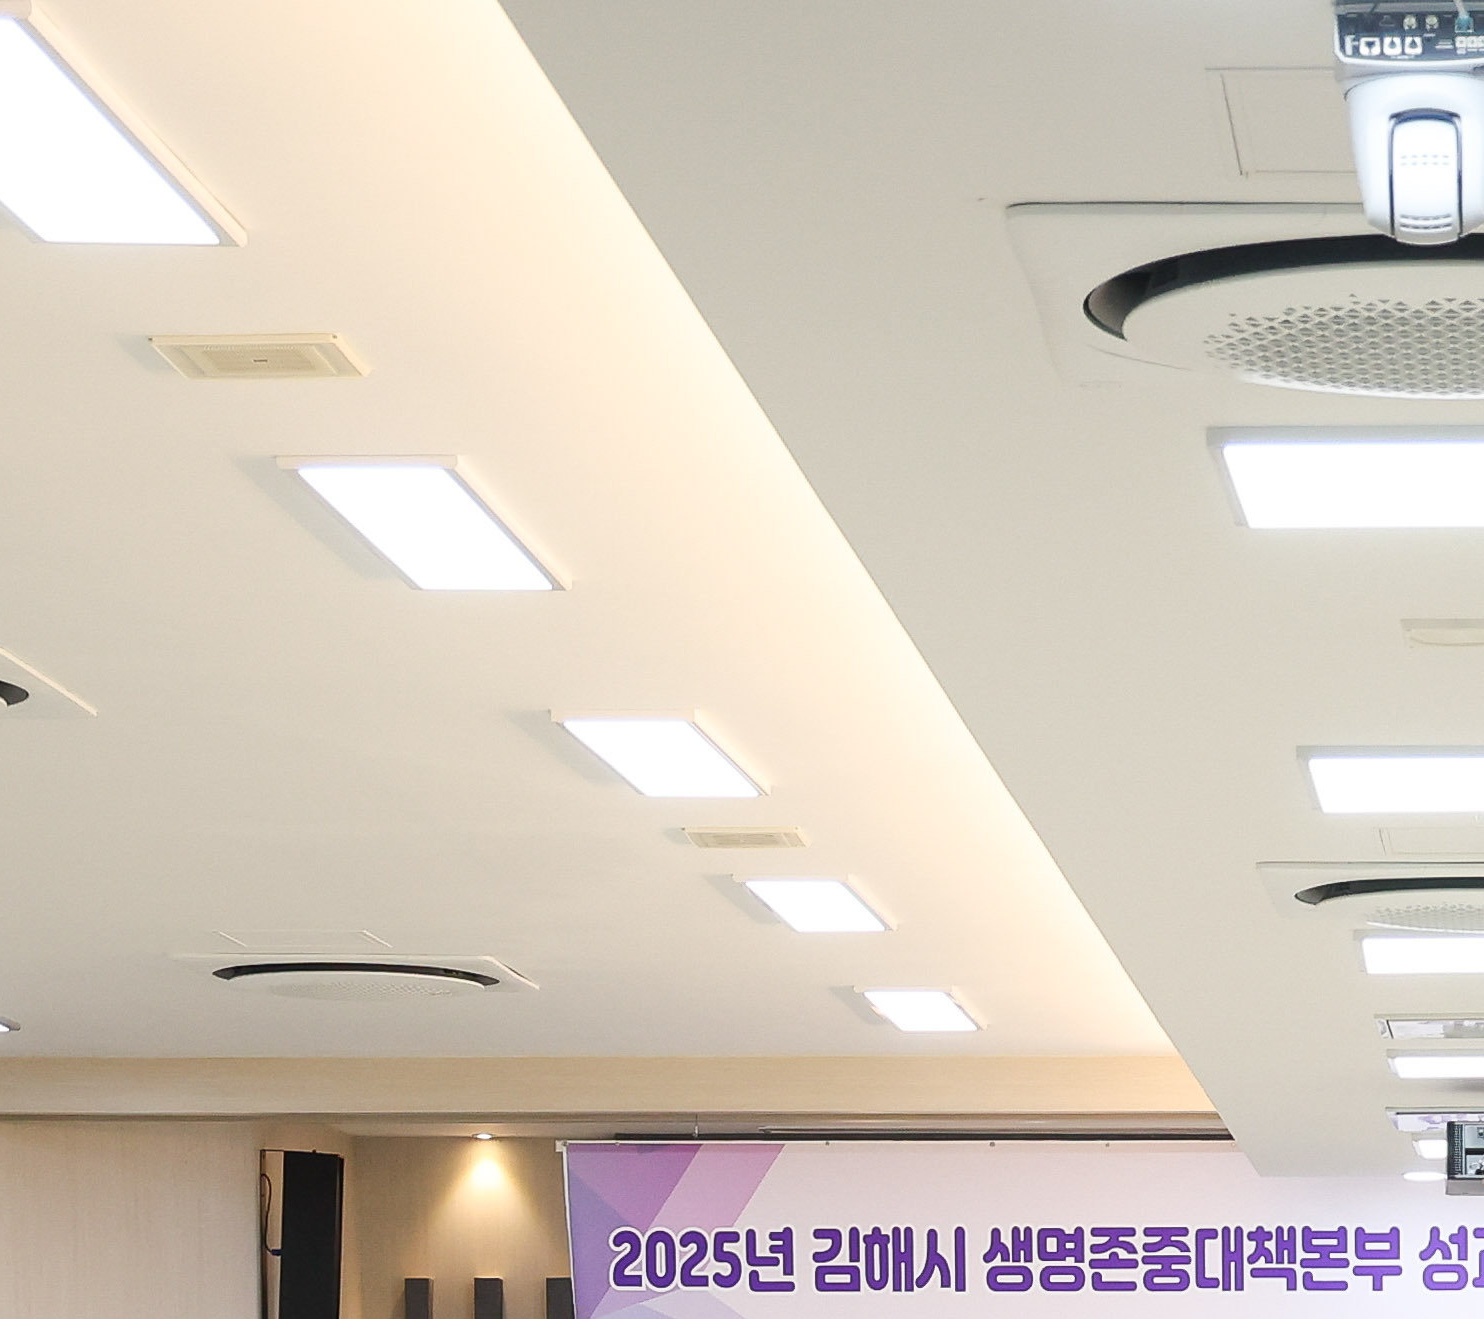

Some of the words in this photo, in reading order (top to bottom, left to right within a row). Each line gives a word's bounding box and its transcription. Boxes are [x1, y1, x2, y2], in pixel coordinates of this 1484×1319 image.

[611, 1229, 796, 1292] 2025년
[813, 1227, 967, 1292] 김해시
[984, 1226, 1404, 1292] 생명존중대책본부
